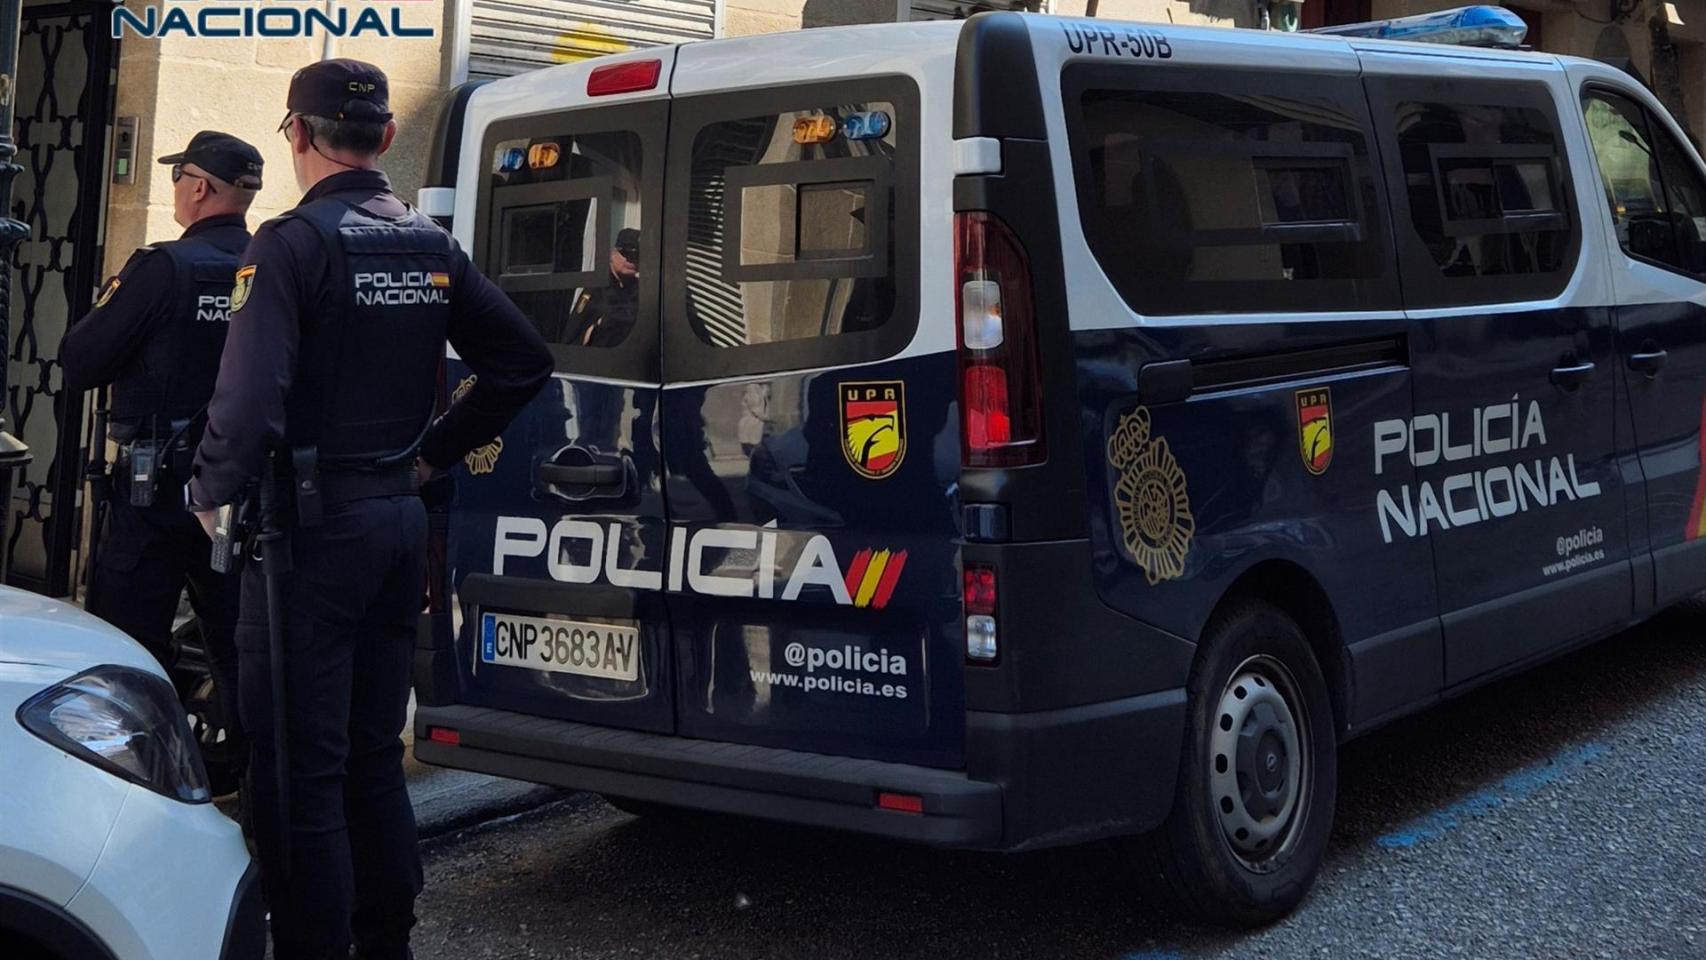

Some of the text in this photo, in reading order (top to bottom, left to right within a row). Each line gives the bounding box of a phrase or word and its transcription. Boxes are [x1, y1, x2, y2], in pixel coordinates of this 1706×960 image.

[1058, 22, 1172, 59] UPR-50B
[348, 81, 376, 93] CNP
[354, 271, 435, 289] POLICIA
[355, 288, 449, 305] NACIONAL
[847, 387, 896, 401] UPR
[1300, 392, 1328, 407] UPR
[1373, 393, 1547, 475] POLICÍA
[1376, 453, 1602, 544] NACIONAL
[1555, 525, 1604, 558] @policia
[493, 515, 854, 606] POLICÍA
[1542, 549, 1605, 577] www.policia.es
[495, 620, 537, 660] CNP
[540, 625, 600, 668] 3683
[784, 642, 908, 675] @policia
[750, 670, 908, 699] www.policia.es
